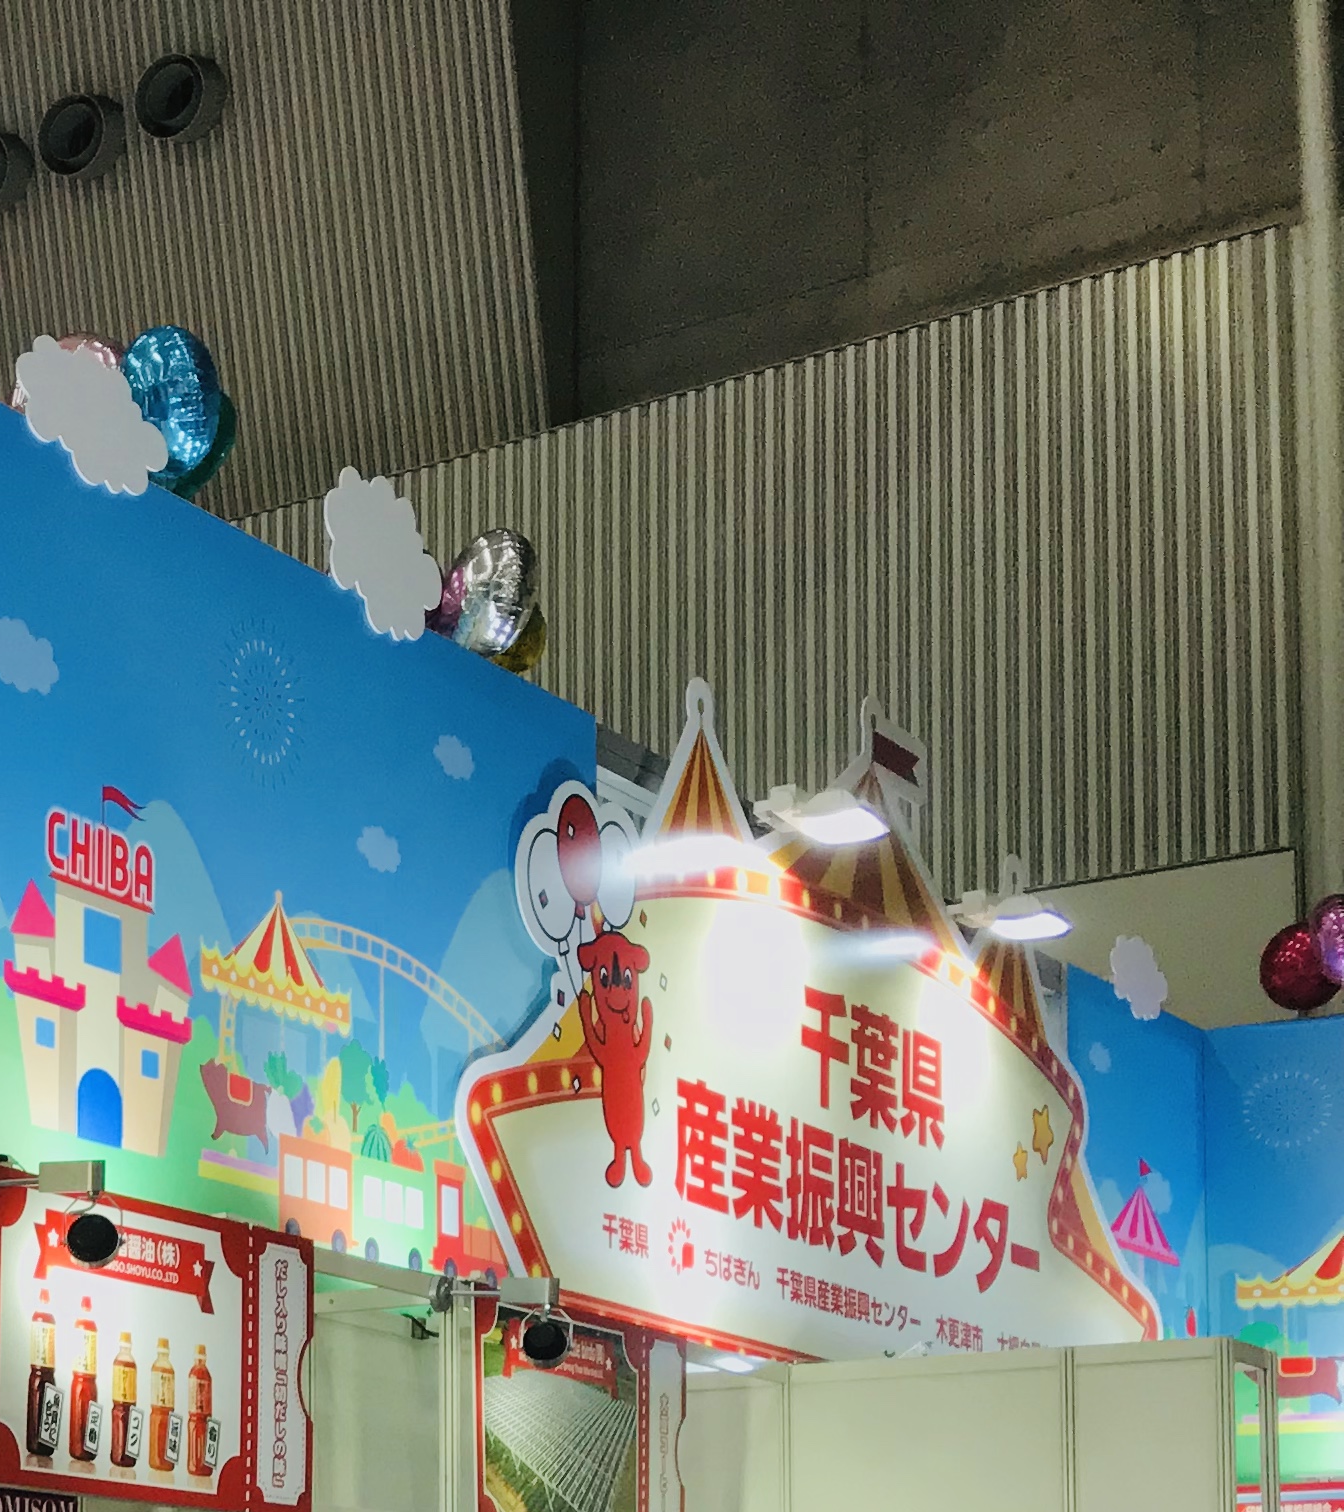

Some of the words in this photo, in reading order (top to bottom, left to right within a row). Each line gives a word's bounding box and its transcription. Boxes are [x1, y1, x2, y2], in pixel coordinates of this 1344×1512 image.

[48, 810, 154, 907] CHIBA
[801, 984, 947, 1152] 千葉県
[674, 1077, 1042, 1295] 産業振興センター
[602, 1212, 650, 1260] 千葉県
[704, 1248, 761, 1292] ちばぎん
[776, 1266, 922, 1332] 千葉県産業振興センター
[936, 1314, 984, 1352] 木更津市
